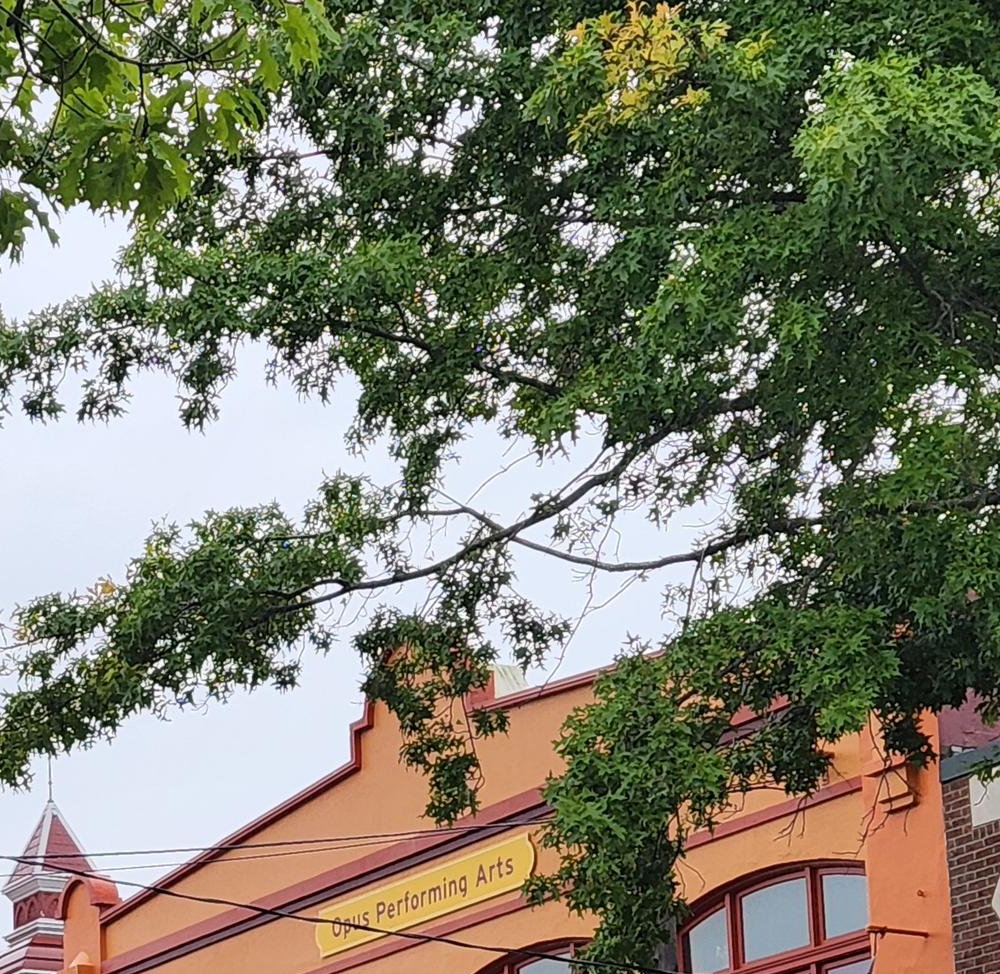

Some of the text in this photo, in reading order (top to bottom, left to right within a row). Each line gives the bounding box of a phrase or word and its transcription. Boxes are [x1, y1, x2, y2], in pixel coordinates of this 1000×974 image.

[331, 856, 514, 939] Opus Performing Arts
